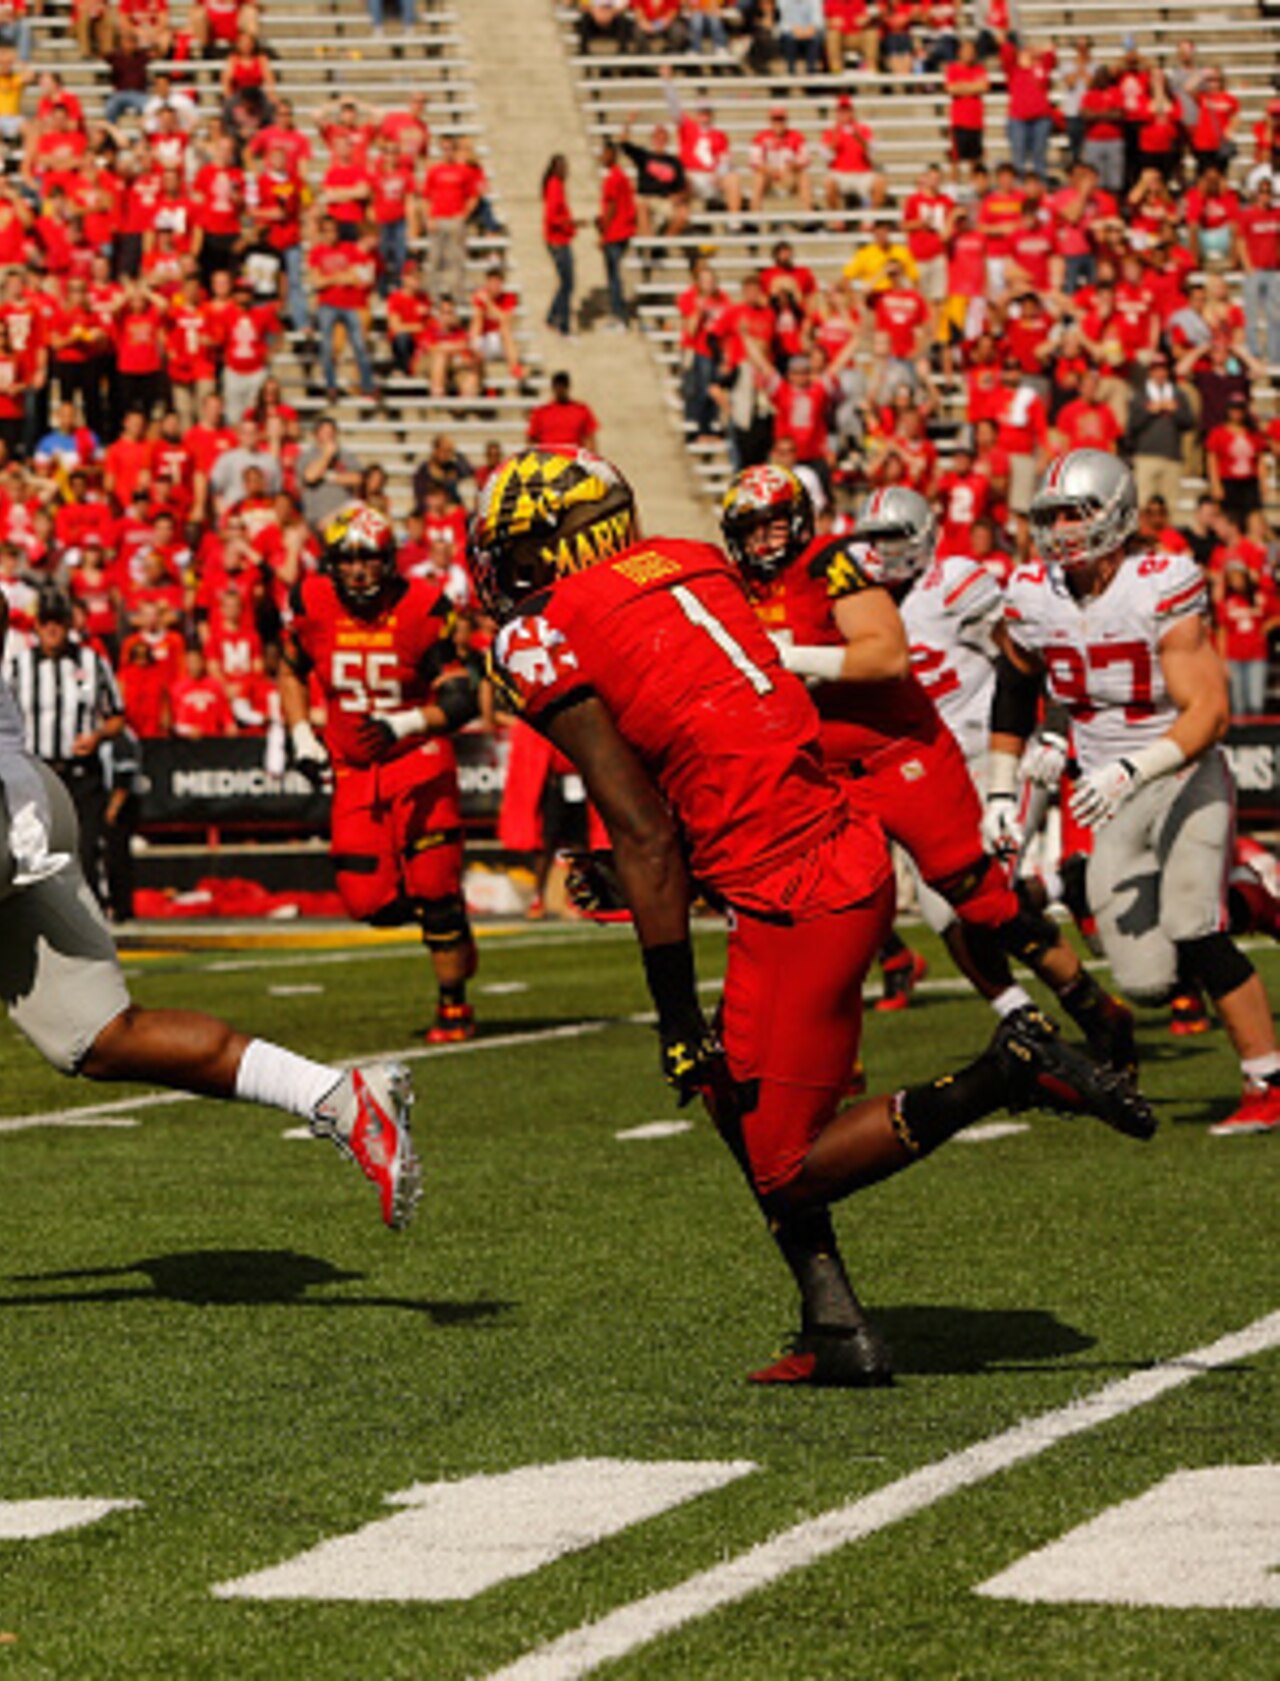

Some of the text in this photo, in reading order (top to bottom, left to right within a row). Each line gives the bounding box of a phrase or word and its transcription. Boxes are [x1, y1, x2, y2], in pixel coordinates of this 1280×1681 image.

[332, 651, 402, 712] 55
[670, 583, 775, 695] 1
[1043, 637, 1153, 725] 97
